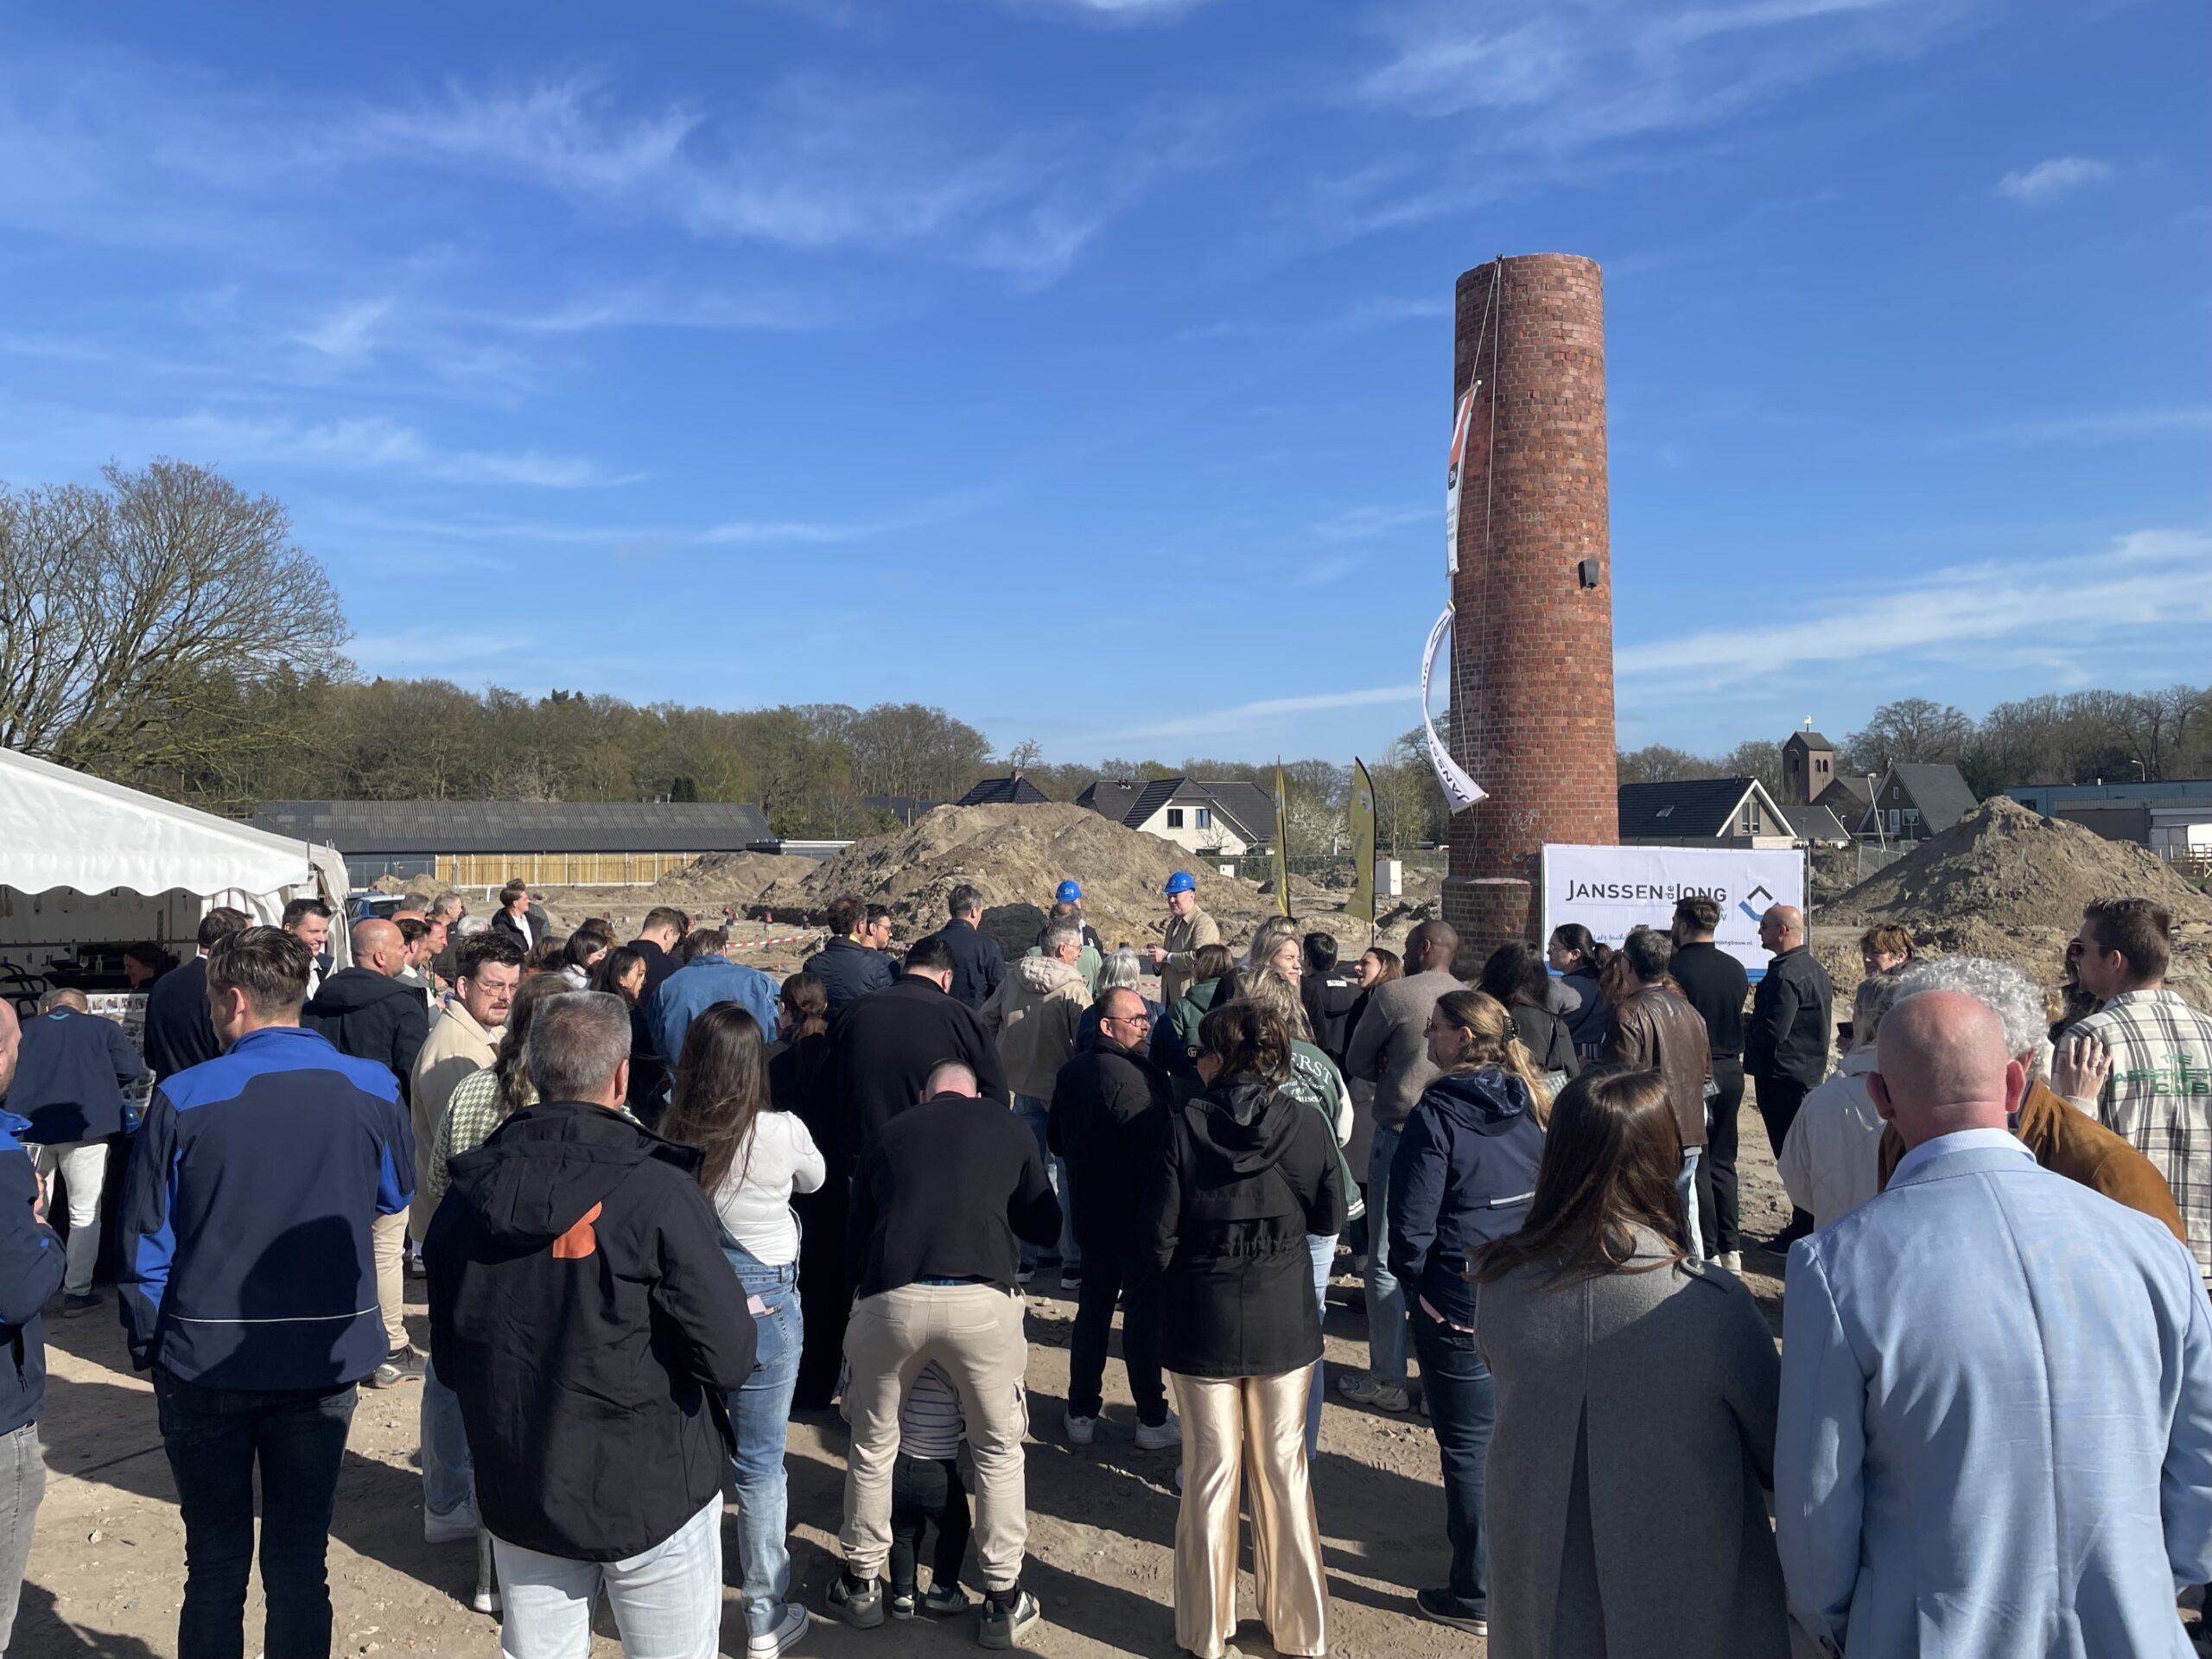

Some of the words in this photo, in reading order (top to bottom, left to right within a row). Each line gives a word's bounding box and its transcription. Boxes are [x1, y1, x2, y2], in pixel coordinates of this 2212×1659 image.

[1565, 880, 1663, 901] JANSSEN
[1665, 885, 1675, 899] de
[1672, 883, 1727, 905] JONG
[2160, 1052, 2192, 1065] THE
[2153, 1082, 2209, 1095] CLUB
